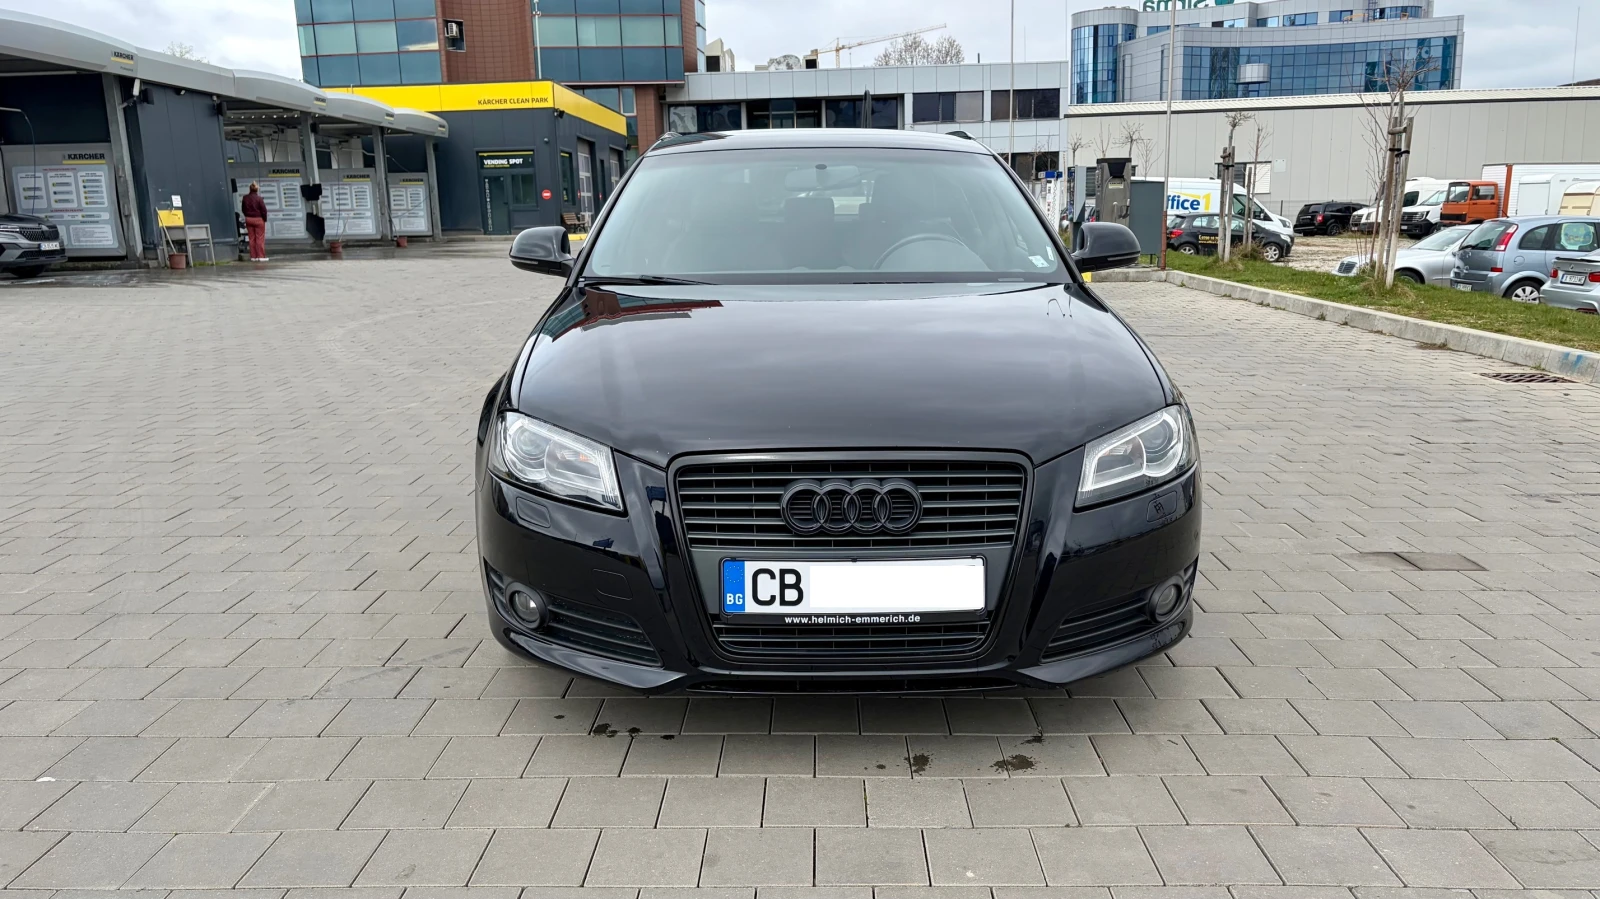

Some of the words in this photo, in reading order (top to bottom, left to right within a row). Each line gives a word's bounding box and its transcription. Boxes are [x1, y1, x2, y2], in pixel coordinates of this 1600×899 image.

[1167, 194, 1201, 211] ffice
[751, 568, 804, 607] CB
[726, 594, 743, 605] BG
[784, 614, 921, 624] www.helmich-emmerich.de
